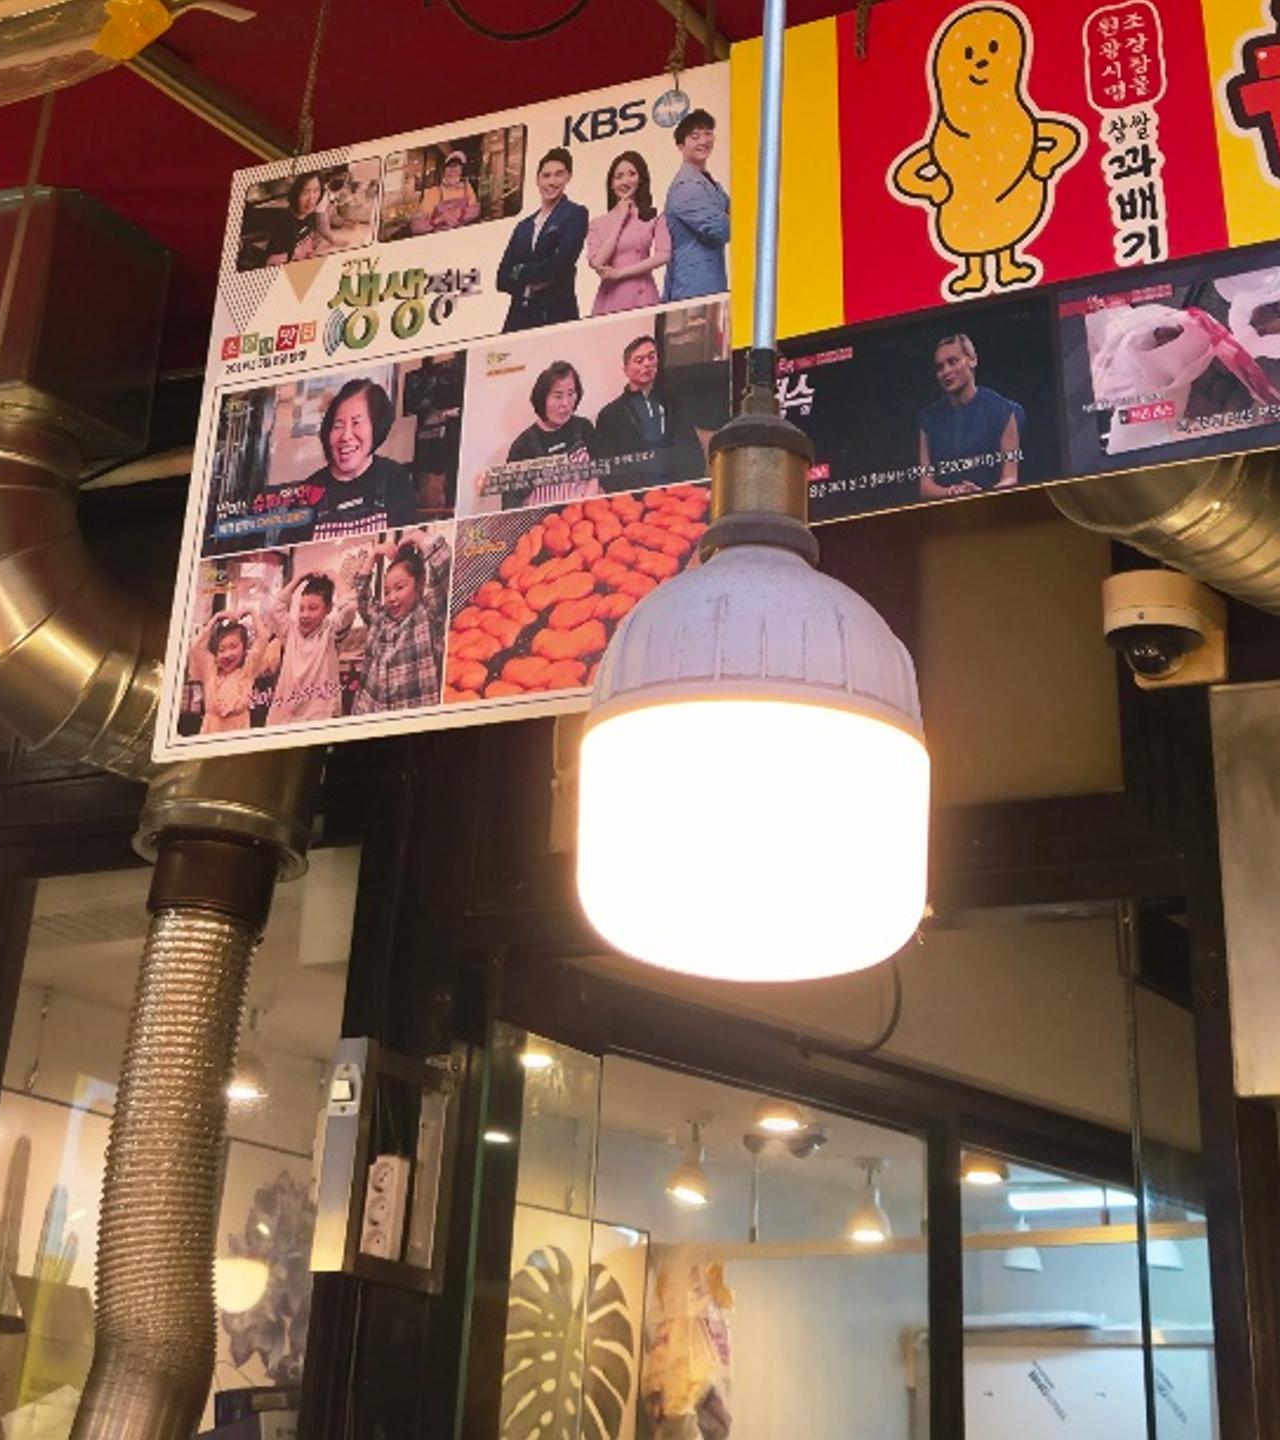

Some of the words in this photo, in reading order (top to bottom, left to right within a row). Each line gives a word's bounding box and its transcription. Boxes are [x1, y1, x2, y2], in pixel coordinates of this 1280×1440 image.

[1097, 10, 1145, 39] 원조
[562, 98, 648, 148] KBS
[1107, 110, 1153, 145] 찹쌀
[1107, 143, 1161, 261] 꽈배기
[326, 266, 484, 350] 생생정보
